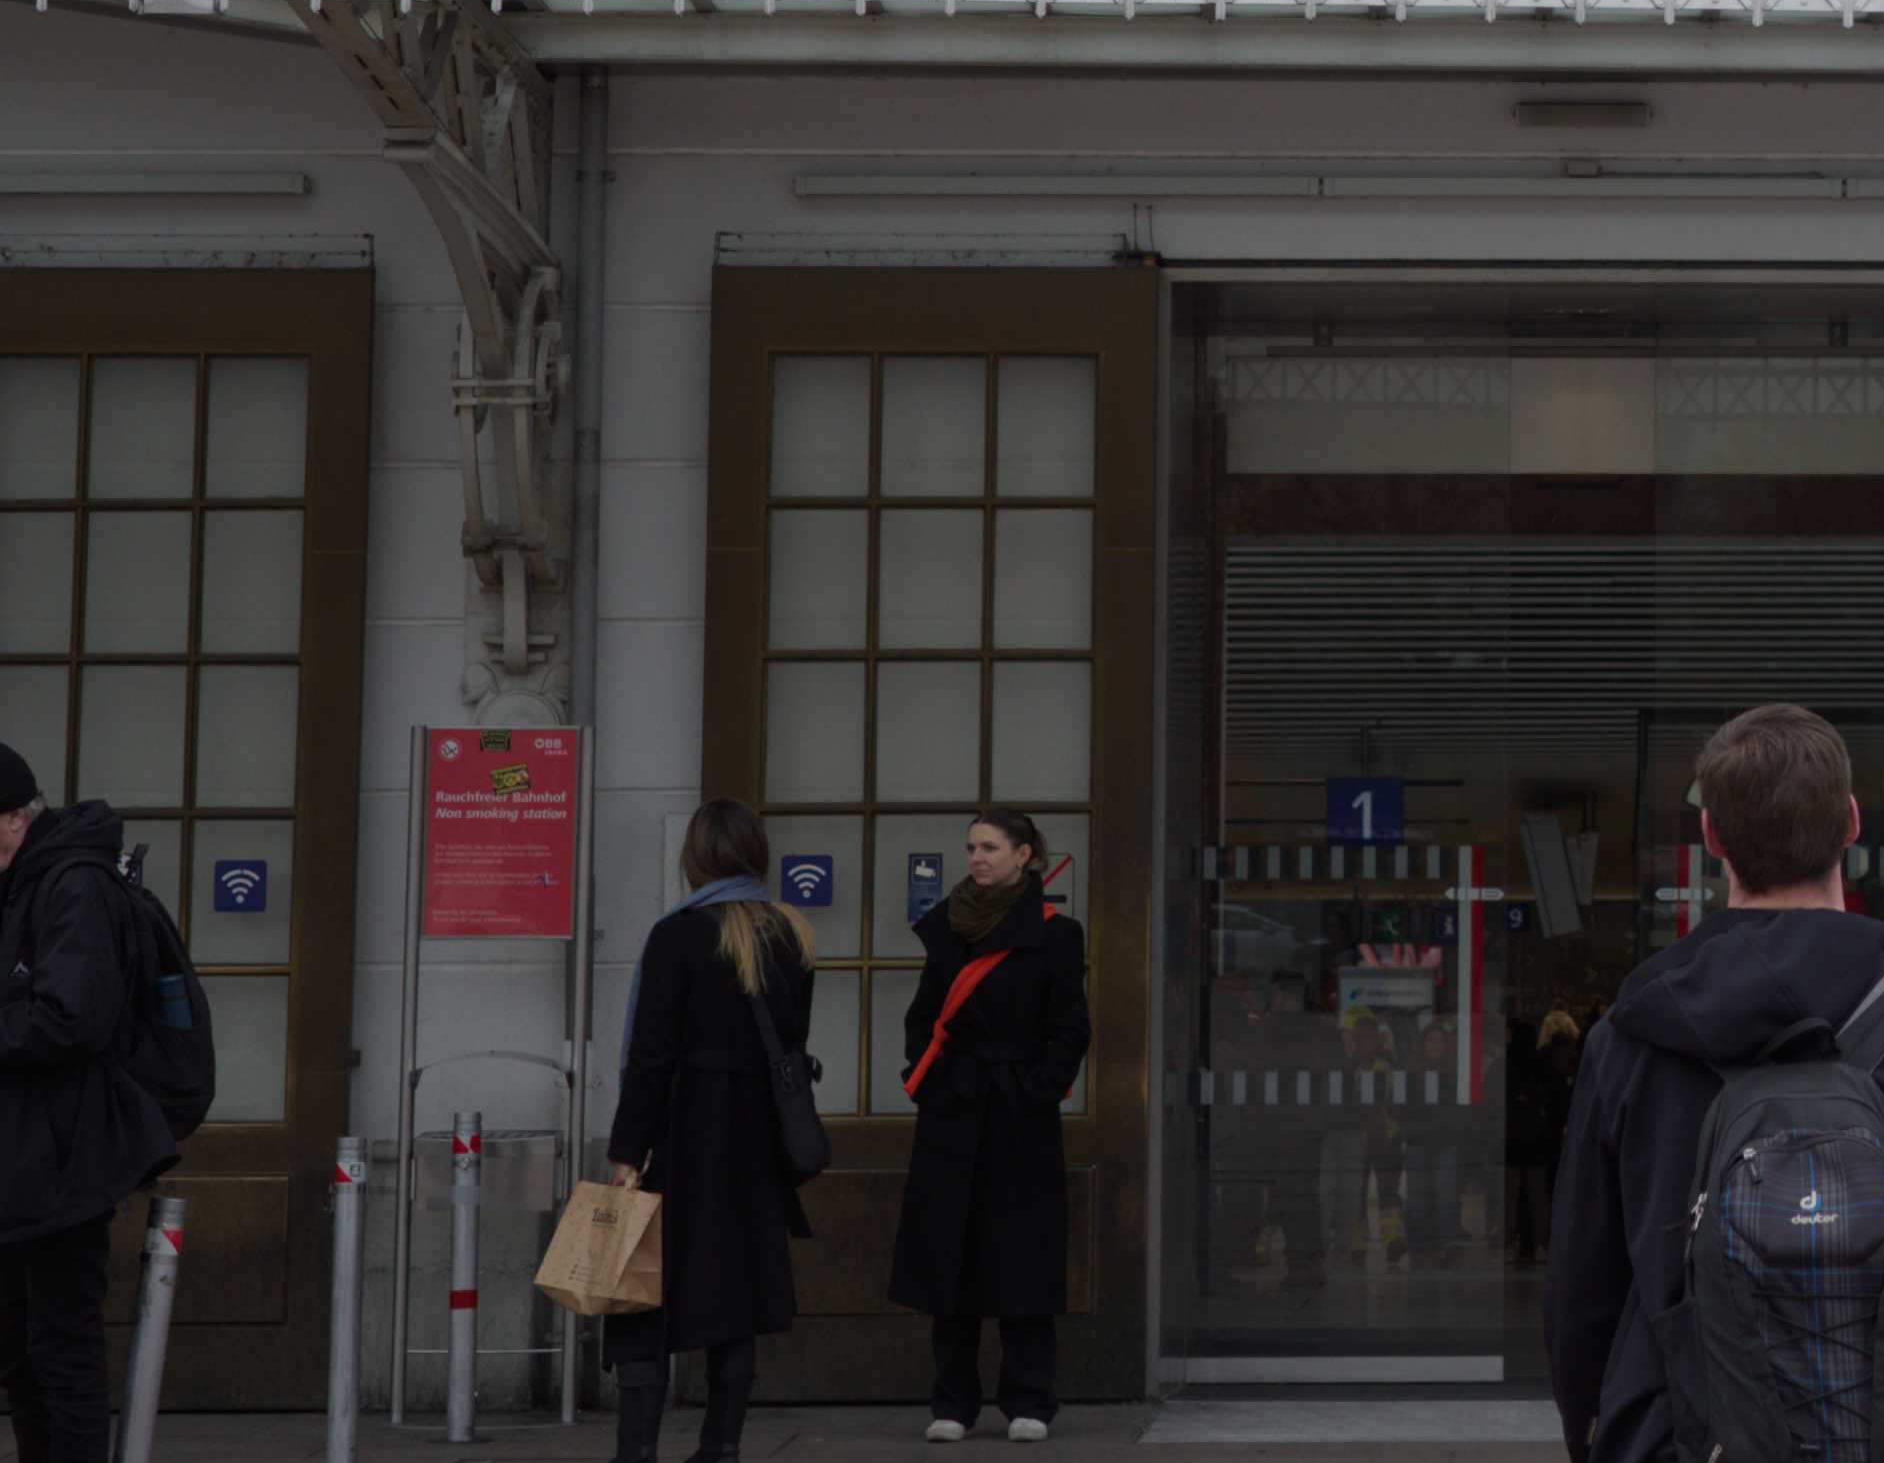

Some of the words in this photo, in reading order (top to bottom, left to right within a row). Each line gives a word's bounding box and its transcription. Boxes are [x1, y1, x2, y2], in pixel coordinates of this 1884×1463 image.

[435, 791, 508, 803] Rauchfreier
[511, 791, 567, 803] Bahnhof
[435, 807, 462, 819] Non
[465, 807, 520, 823] smoking
[522, 807, 568, 819] station
[1351, 790, 1373, 840] 1
[1508, 907, 1523, 929] 9
[1791, 1213, 1840, 1225] deuter
